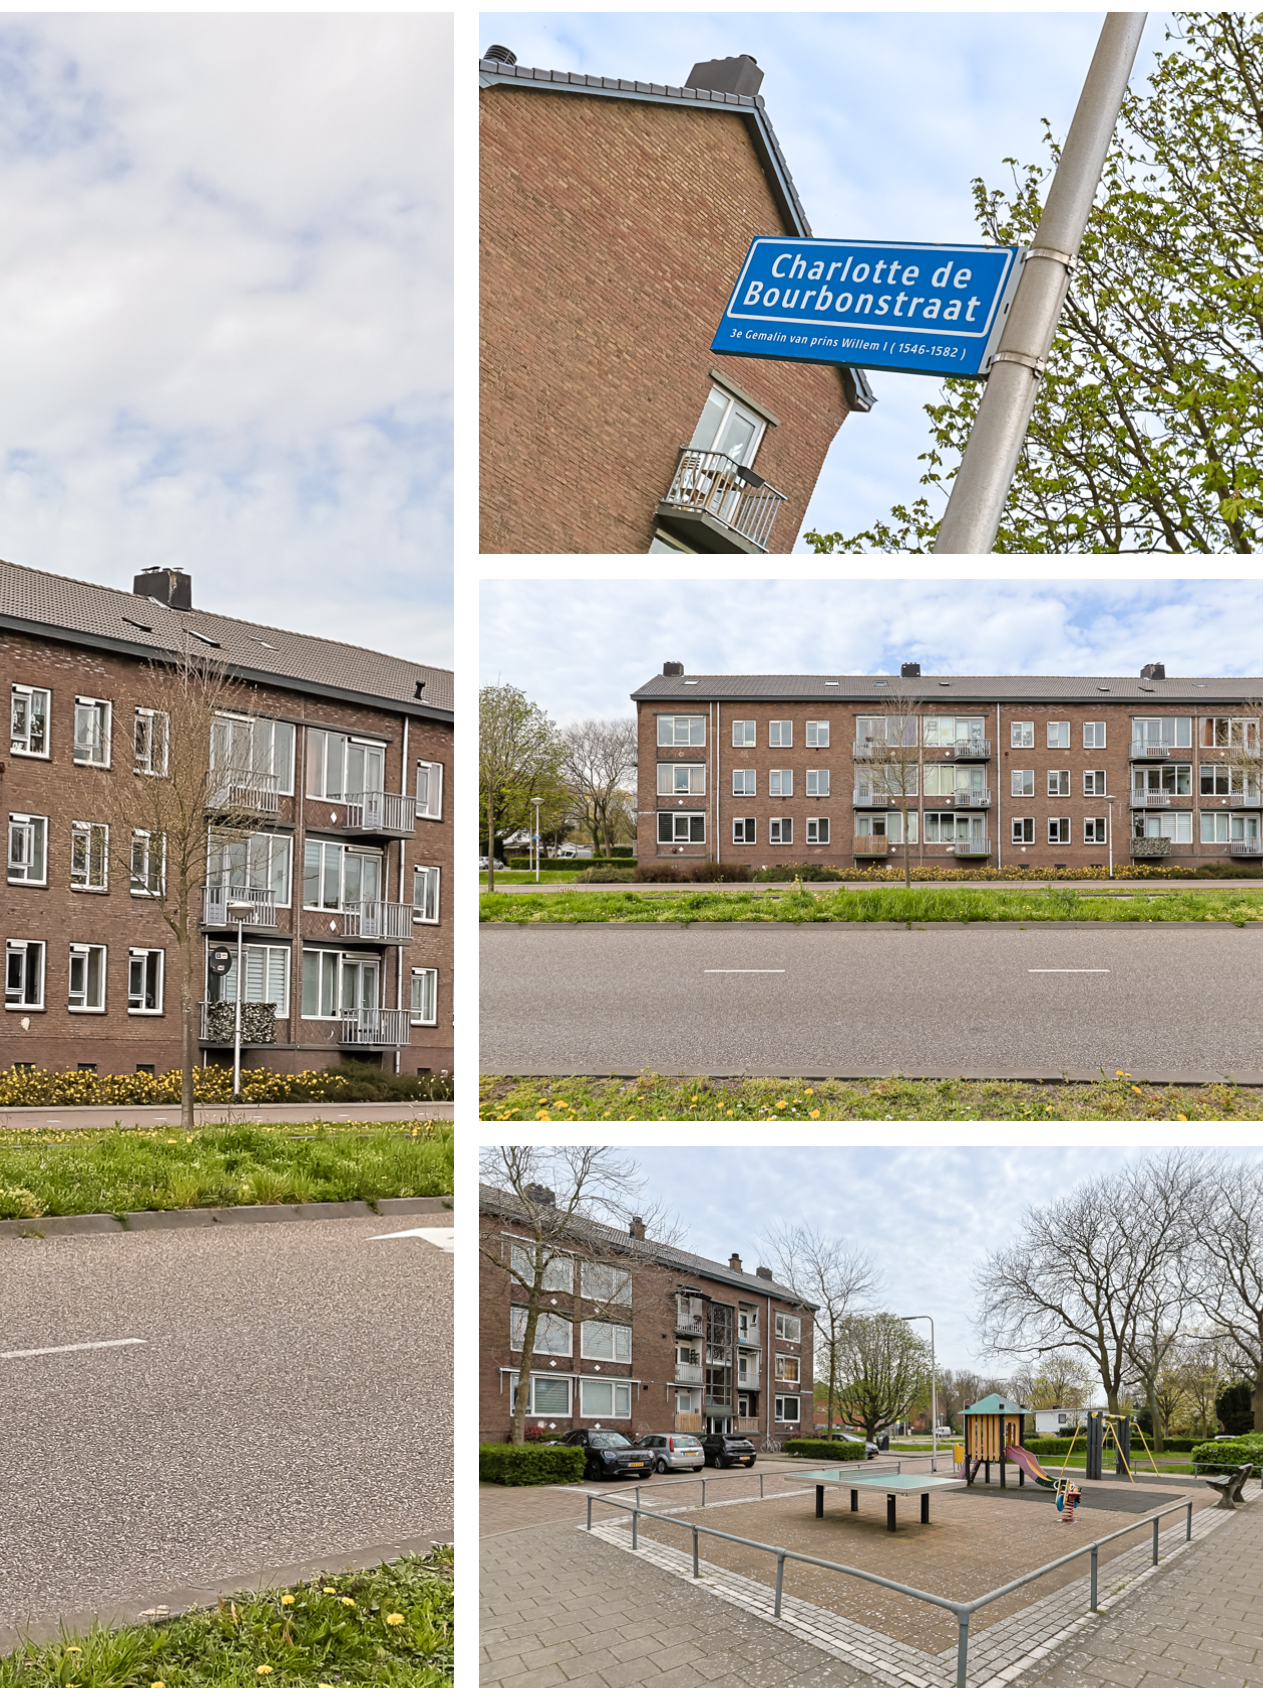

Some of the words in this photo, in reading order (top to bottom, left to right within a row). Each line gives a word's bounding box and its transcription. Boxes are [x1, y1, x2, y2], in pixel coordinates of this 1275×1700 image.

[771, 253, 920, 286] Charlotte
[931, 260, 972, 289] de
[742, 280, 981, 322] Bourbonstraat
[729, 328, 743, 339] 3e
[744, 329, 787, 343] Gemalin
[789, 335, 808, 345] van
[809, 335, 839, 348] prins
[841, 337, 880, 351] Willem
[898, 342, 958, 358] 1546-1582
